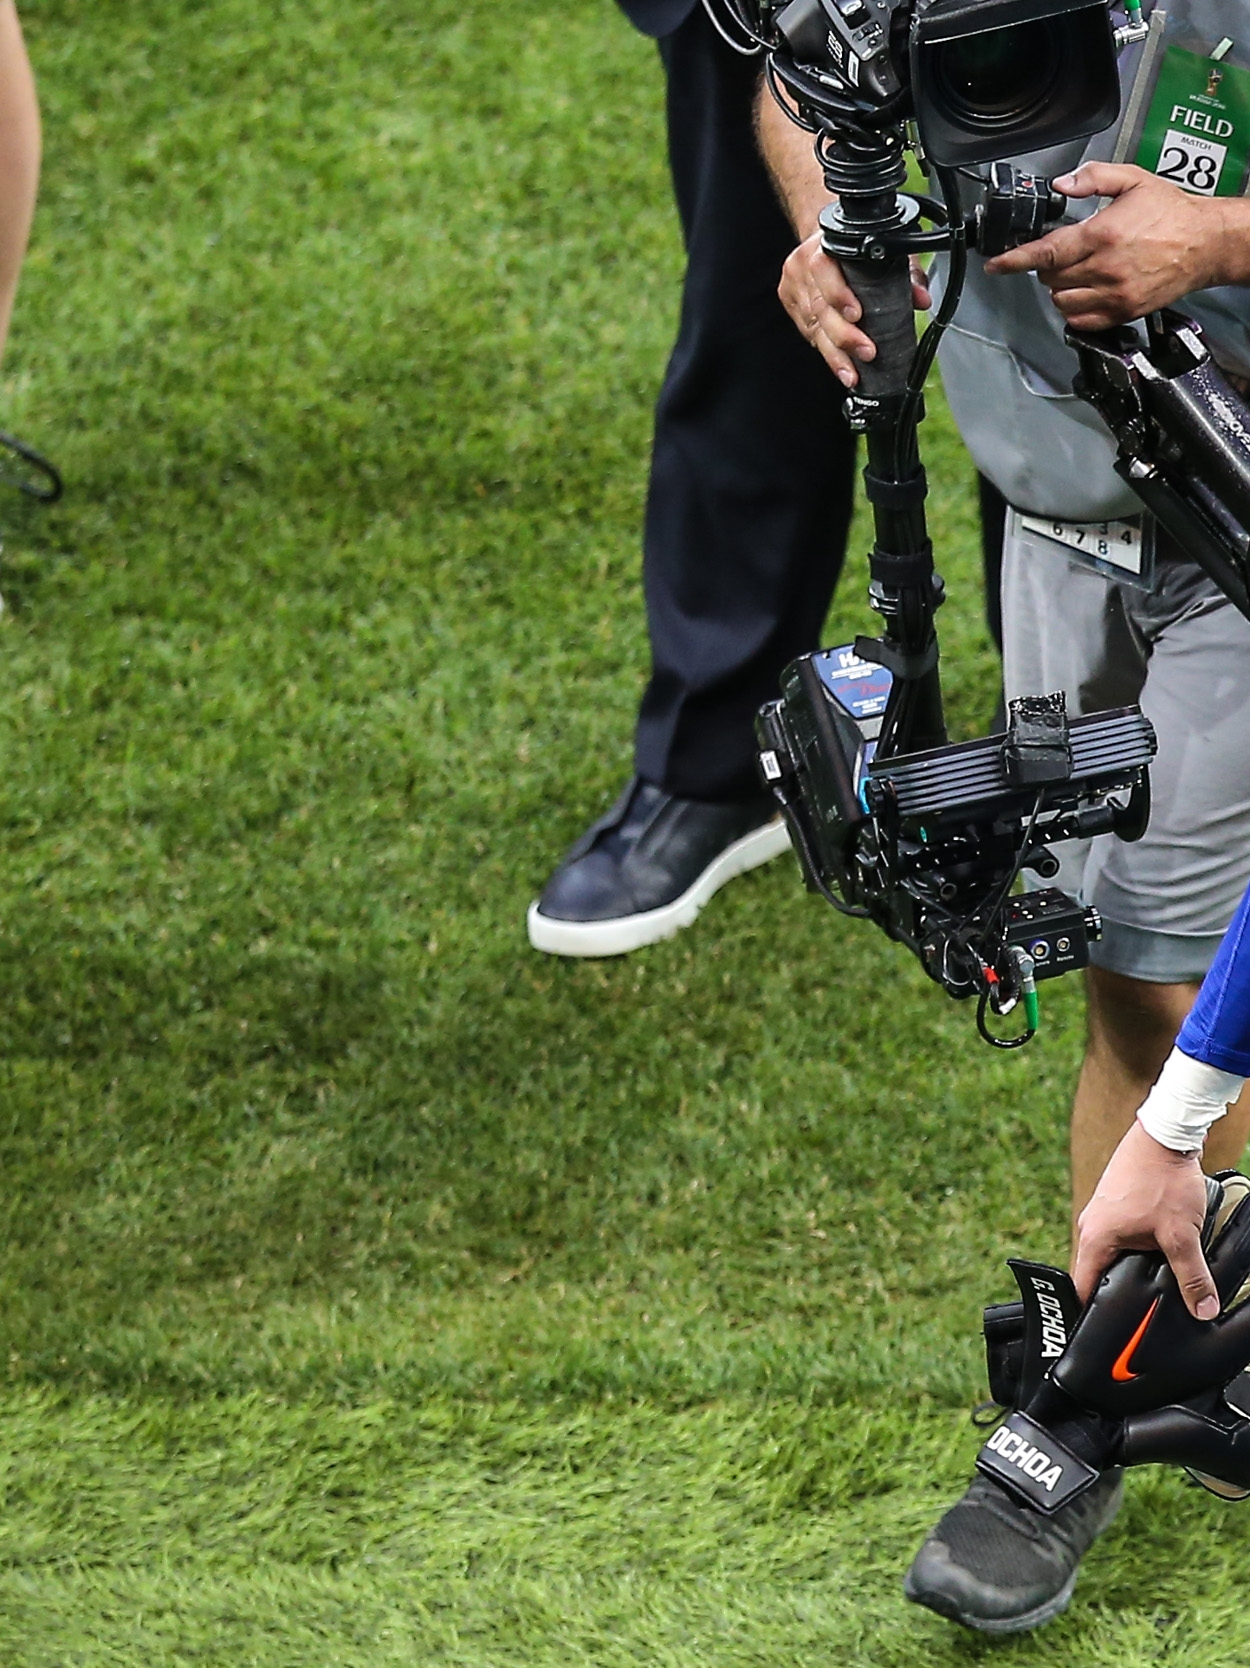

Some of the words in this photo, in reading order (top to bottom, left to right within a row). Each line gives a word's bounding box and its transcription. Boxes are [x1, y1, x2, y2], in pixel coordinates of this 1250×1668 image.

[1169, 104, 1234, 138] FIELD
[1181, 136, 1212, 151] MATCH
[1156, 146, 1218, 190] 28
[1052, 522, 1063, 536] 6
[1076, 529, 1085, 544] 7
[1098, 540, 1108, 555] 8
[1121, 530, 1132, 545] 4
[1030, 1276, 1056, 1292] G.
[1036, 1292, 1068, 1358] OCHOA
[986, 1425, 1064, 1492] OCHOA
